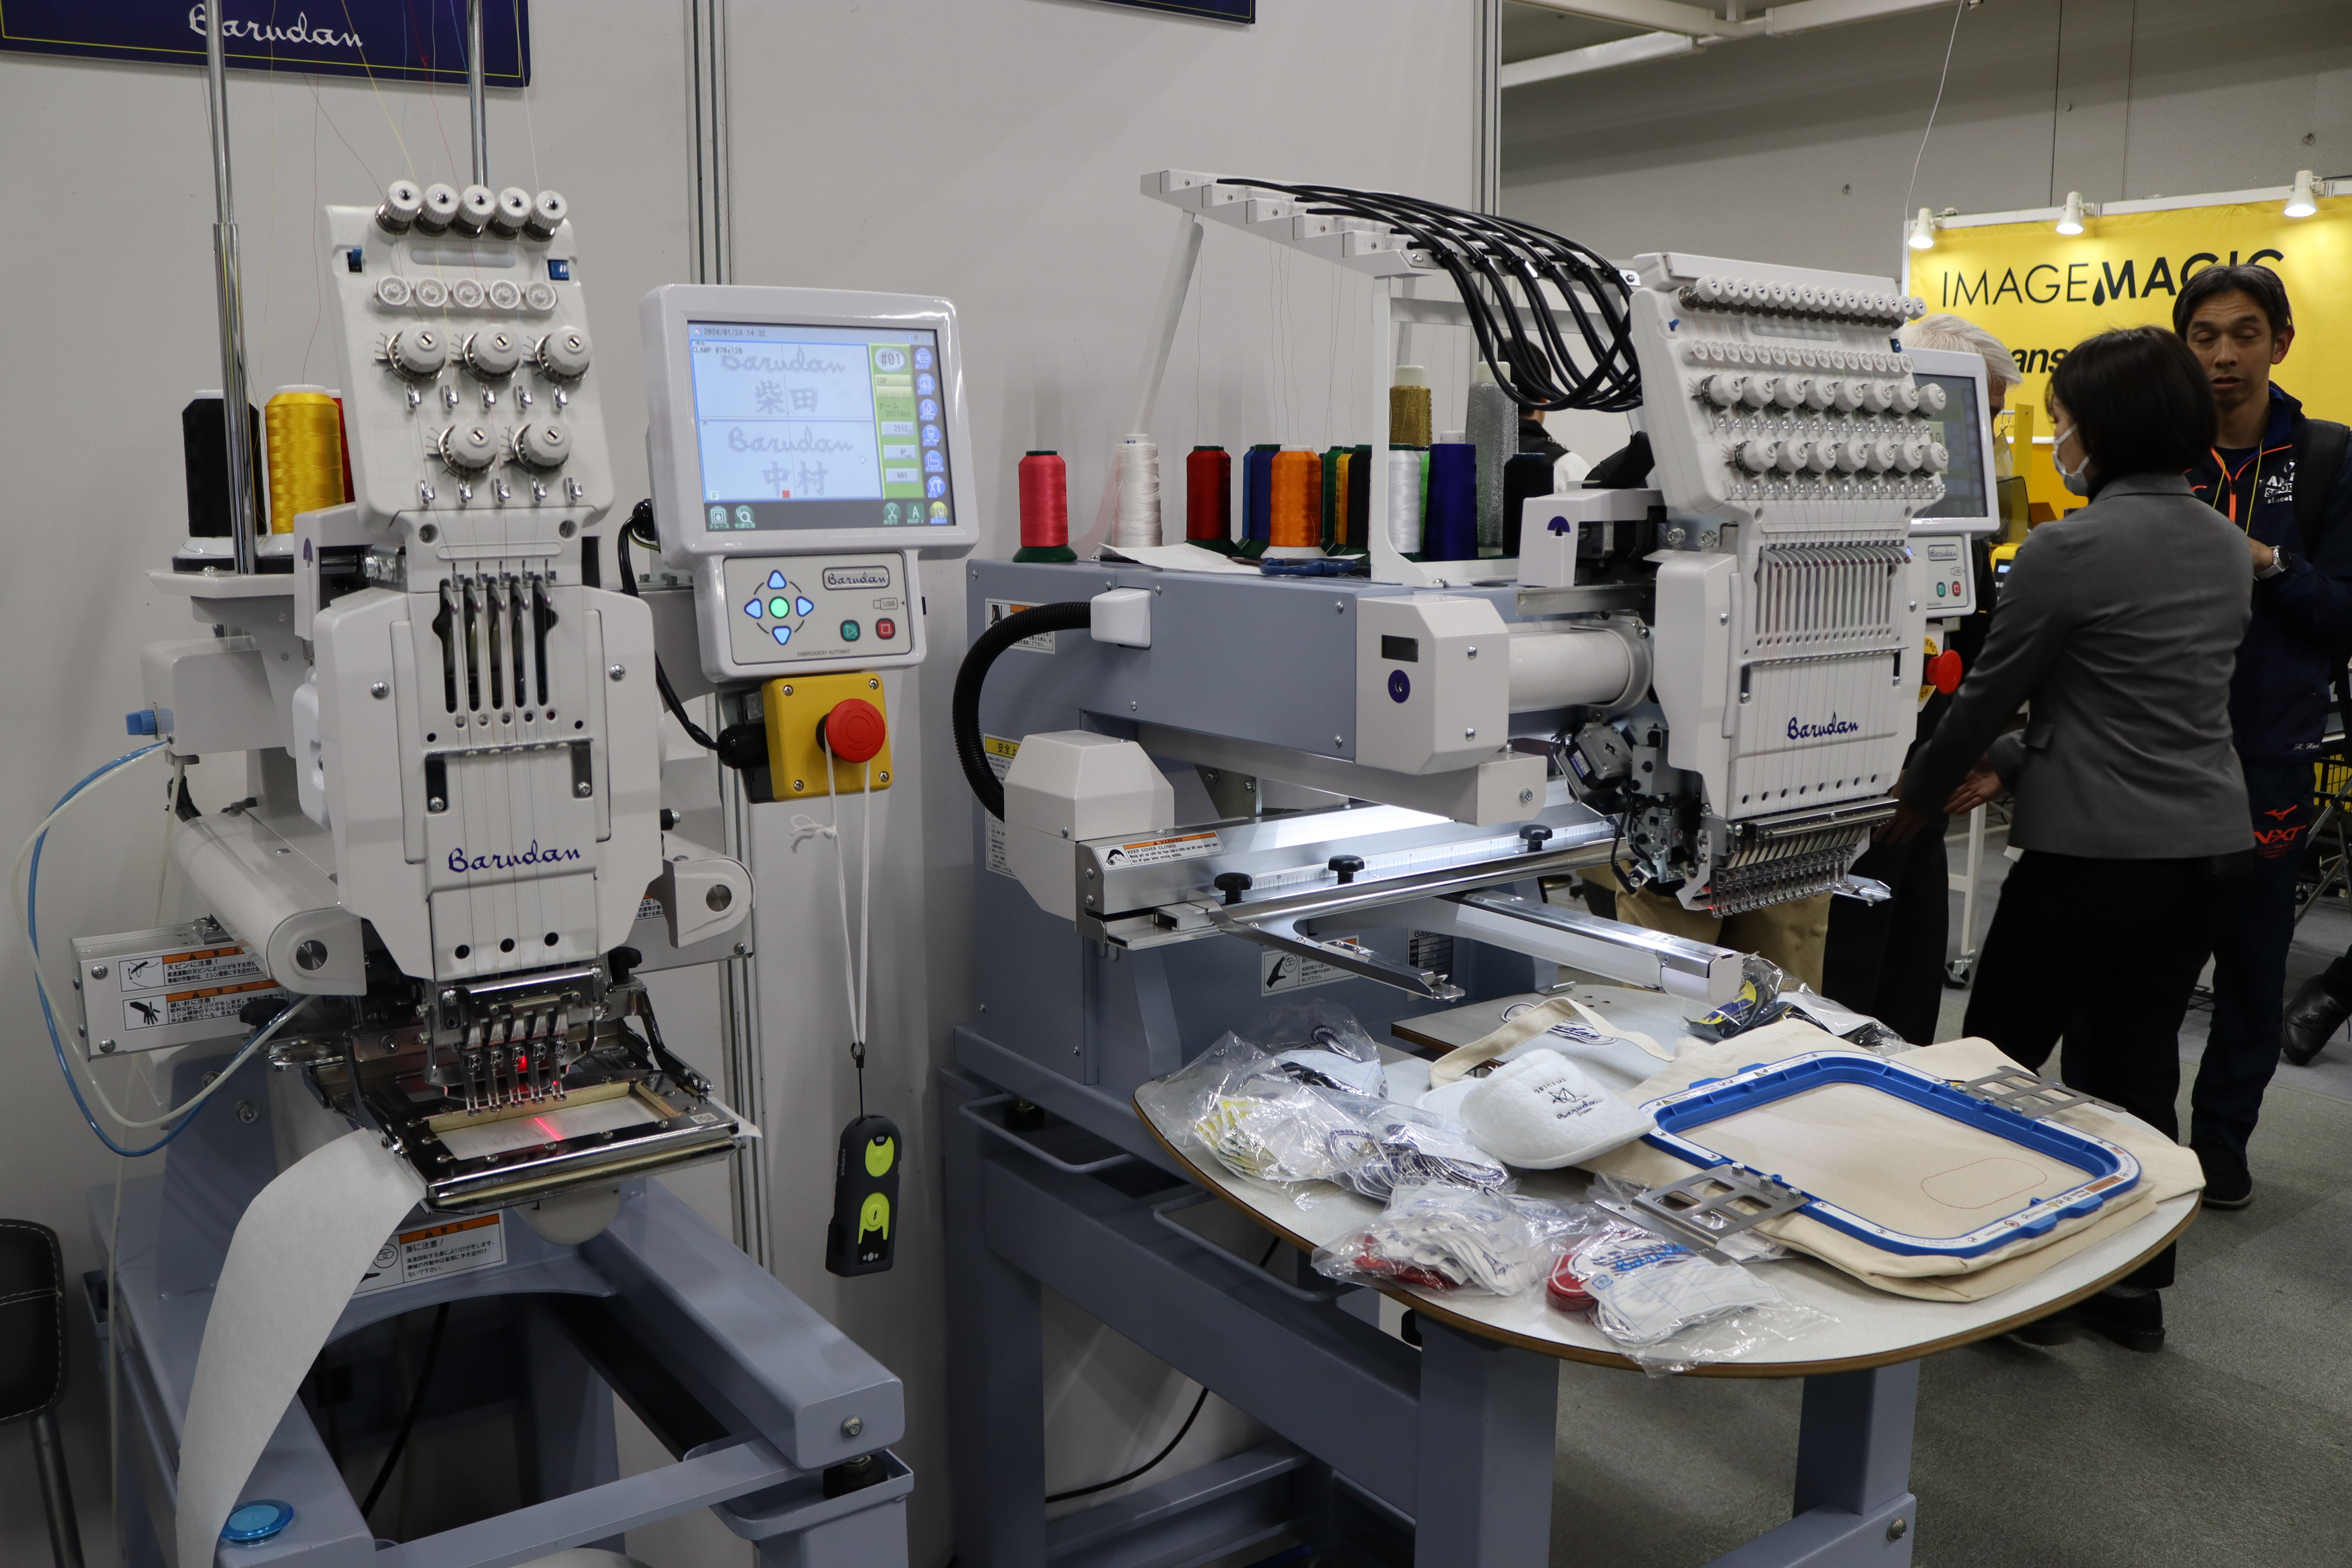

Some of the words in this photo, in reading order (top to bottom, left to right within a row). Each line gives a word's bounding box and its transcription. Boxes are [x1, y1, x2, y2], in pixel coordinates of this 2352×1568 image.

[189, 4, 363, 47] Barudan
[704, 328, 743, 336] 2024/01/24
[881, 352, 900, 366] #01
[755, 380, 818, 415] 柴田
[728, 425, 854, 453] Barudan
[762, 461, 828, 496] 中村
[912, 506, 920, 518] A
[1931, 548, 1956, 557] Barudan
[828, 572, 886, 586] Barudan
[1786, 711, 1859, 740] Barudan
[997, 743, 1017, 756] 安全上
[448, 839, 582, 873] Barudan
[167, 959, 218, 971] 天ビンに注意！
[170, 996, 216, 1009] 縫い針に注意！
[407, 1266, 443, 1278] ないで下さい。
